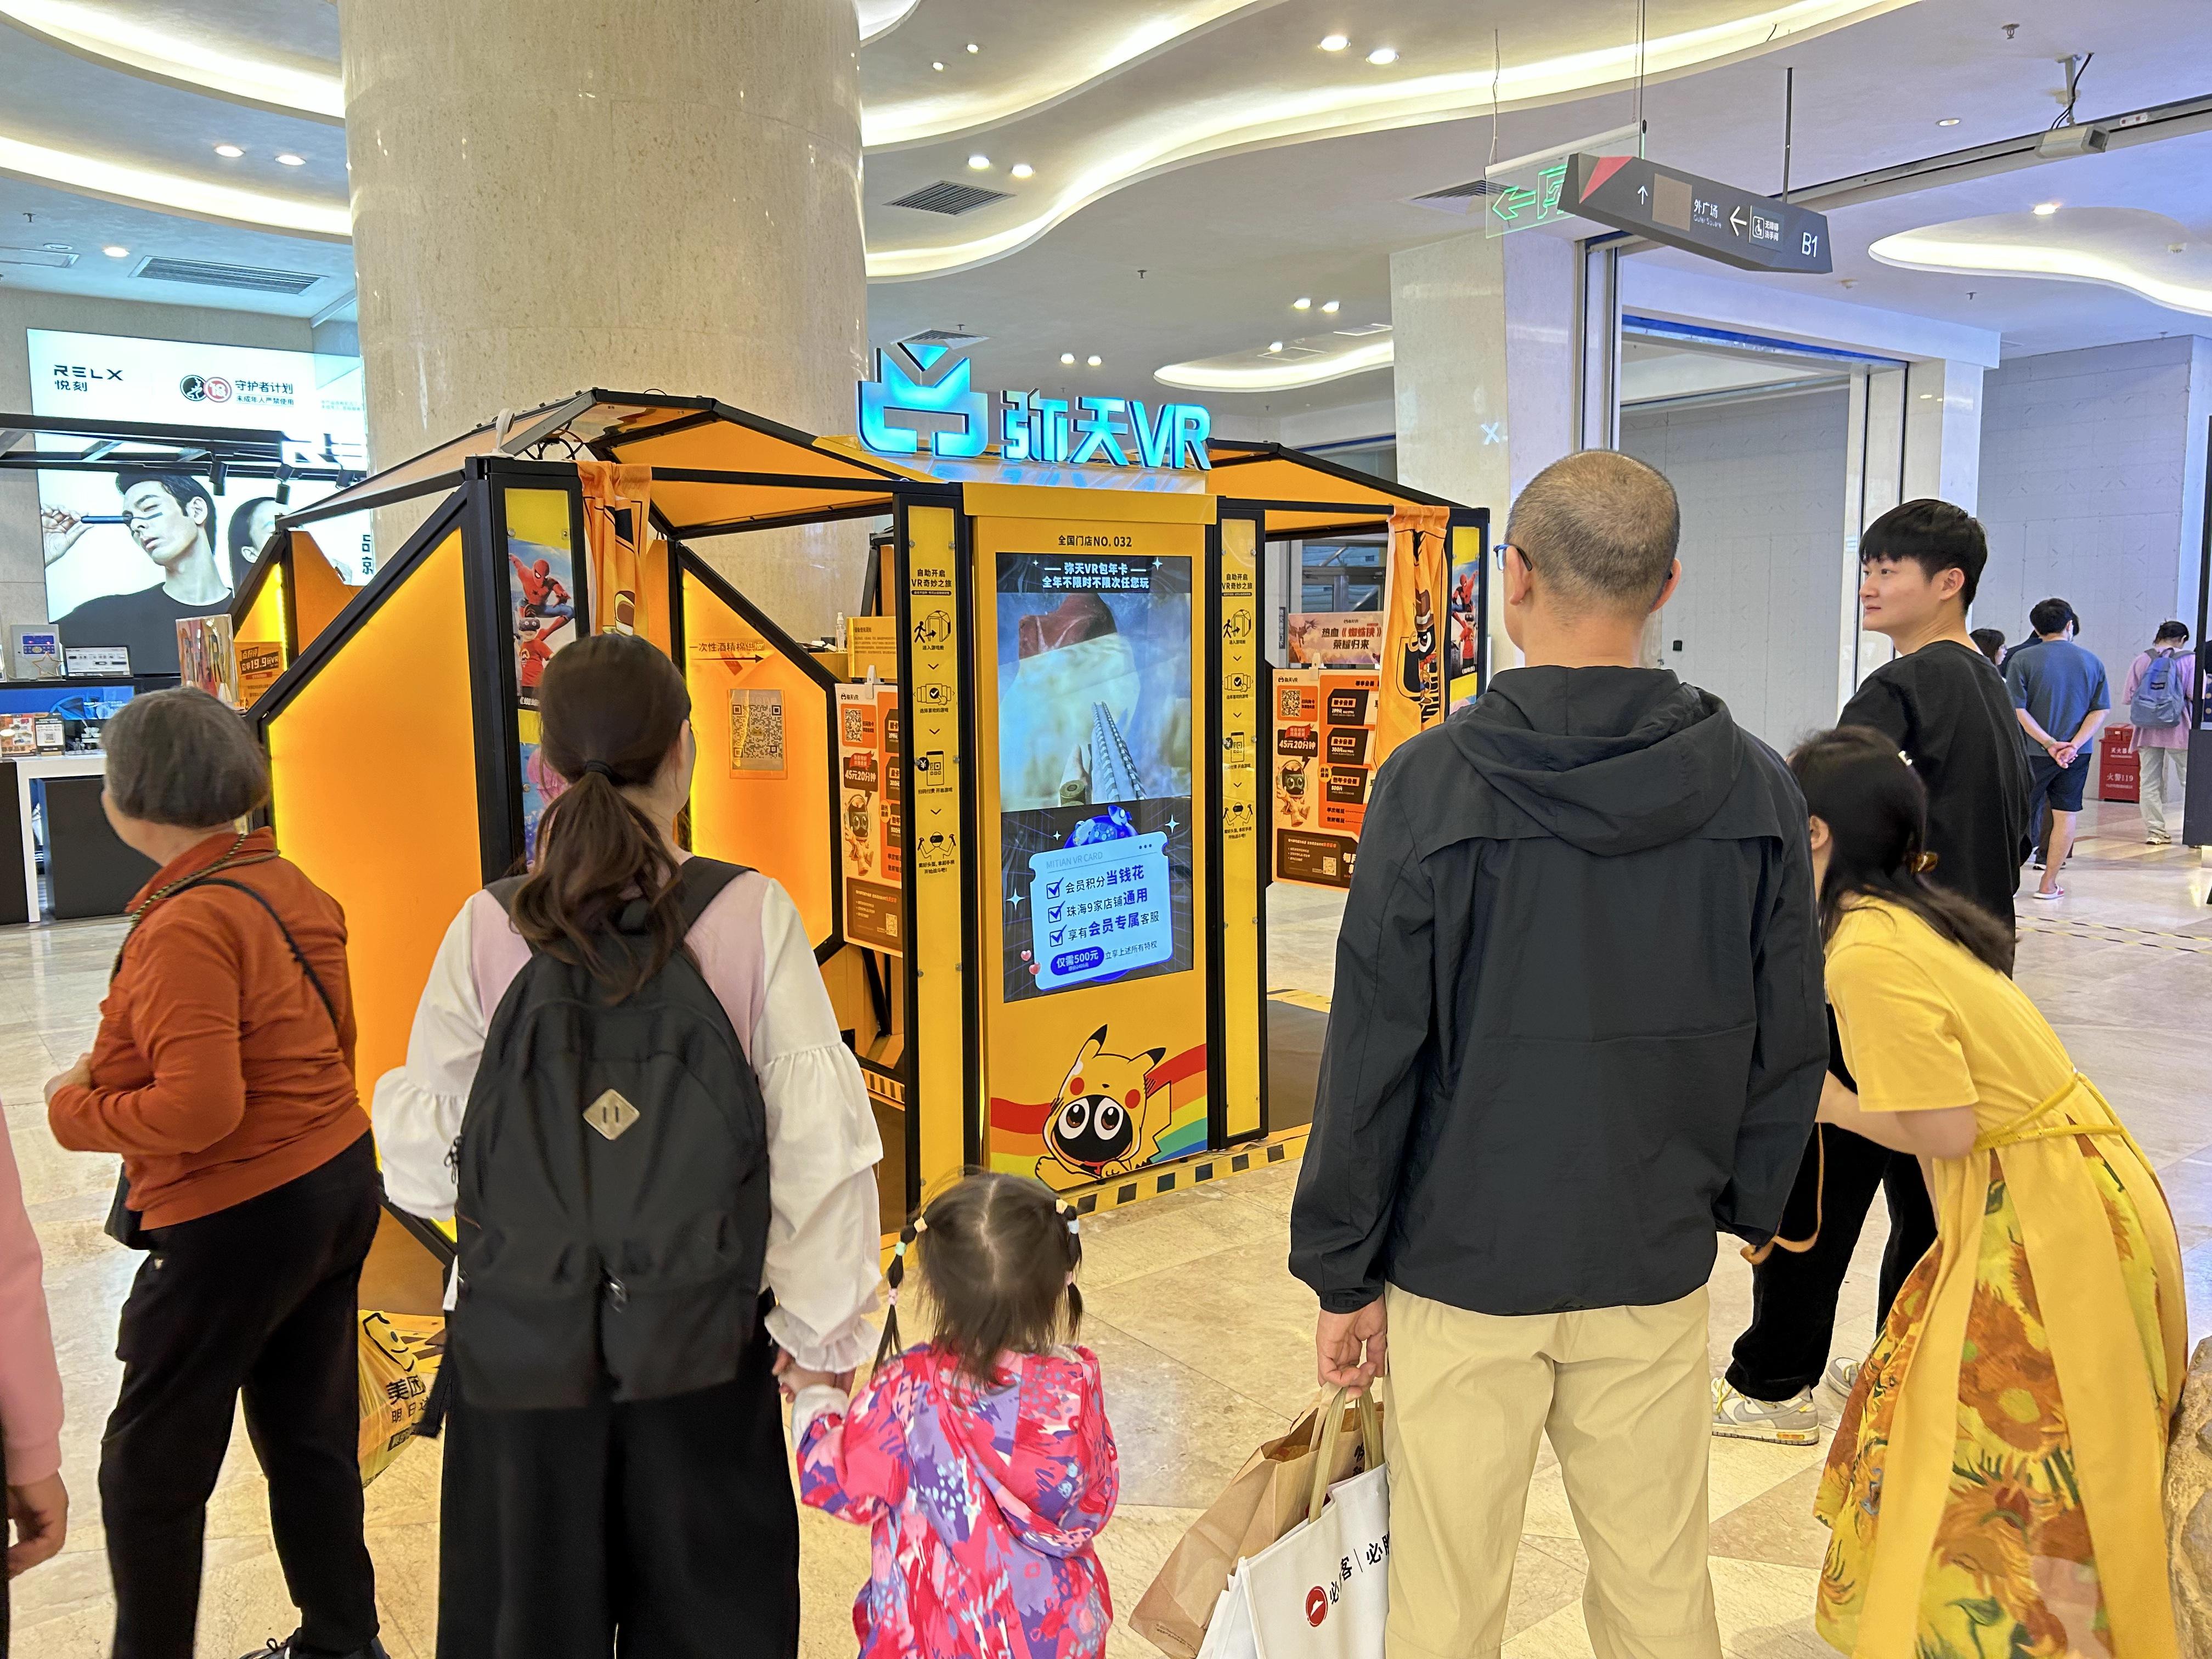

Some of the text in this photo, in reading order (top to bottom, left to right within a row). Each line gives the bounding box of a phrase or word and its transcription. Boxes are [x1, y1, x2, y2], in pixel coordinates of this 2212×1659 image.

[1694, 199, 1718, 219] 外广场
[1801, 232, 1818, 258] B1
[53, 364, 123, 381] RELX
[54, 380, 88, 392] 悦刻
[235, 380, 294, 394] 守护者计划
[1000, 387, 1211, 470] 弥天VR
[917, 568, 946, 578] 自助开启
[1063, 561, 1128, 575] 弥天VR包年卡
[911, 578, 952, 588] VR奇妙之旅
[1041, 575, 1150, 589] 全年不限时不限次任您玩
[1333, 639, 1369, 650] 荣耀归来
[1279, 740, 1316, 750] 45元20分钟
[845, 769, 877, 783] 45元20分钟
[1046, 851, 1103, 870] MITIAN VR CARD
[1065, 864, 1144, 894] 会员积分当钱花
[1066, 888, 1148, 917] 珠海9家店铺通用
[1068, 911, 1159, 941] 享有会员专属客服
[1105, 940, 1158, 960] 立享上述所有特权
[1056, 950, 1099, 968] 仅需500元
[1329, 1556, 1352, 1605] 必客
